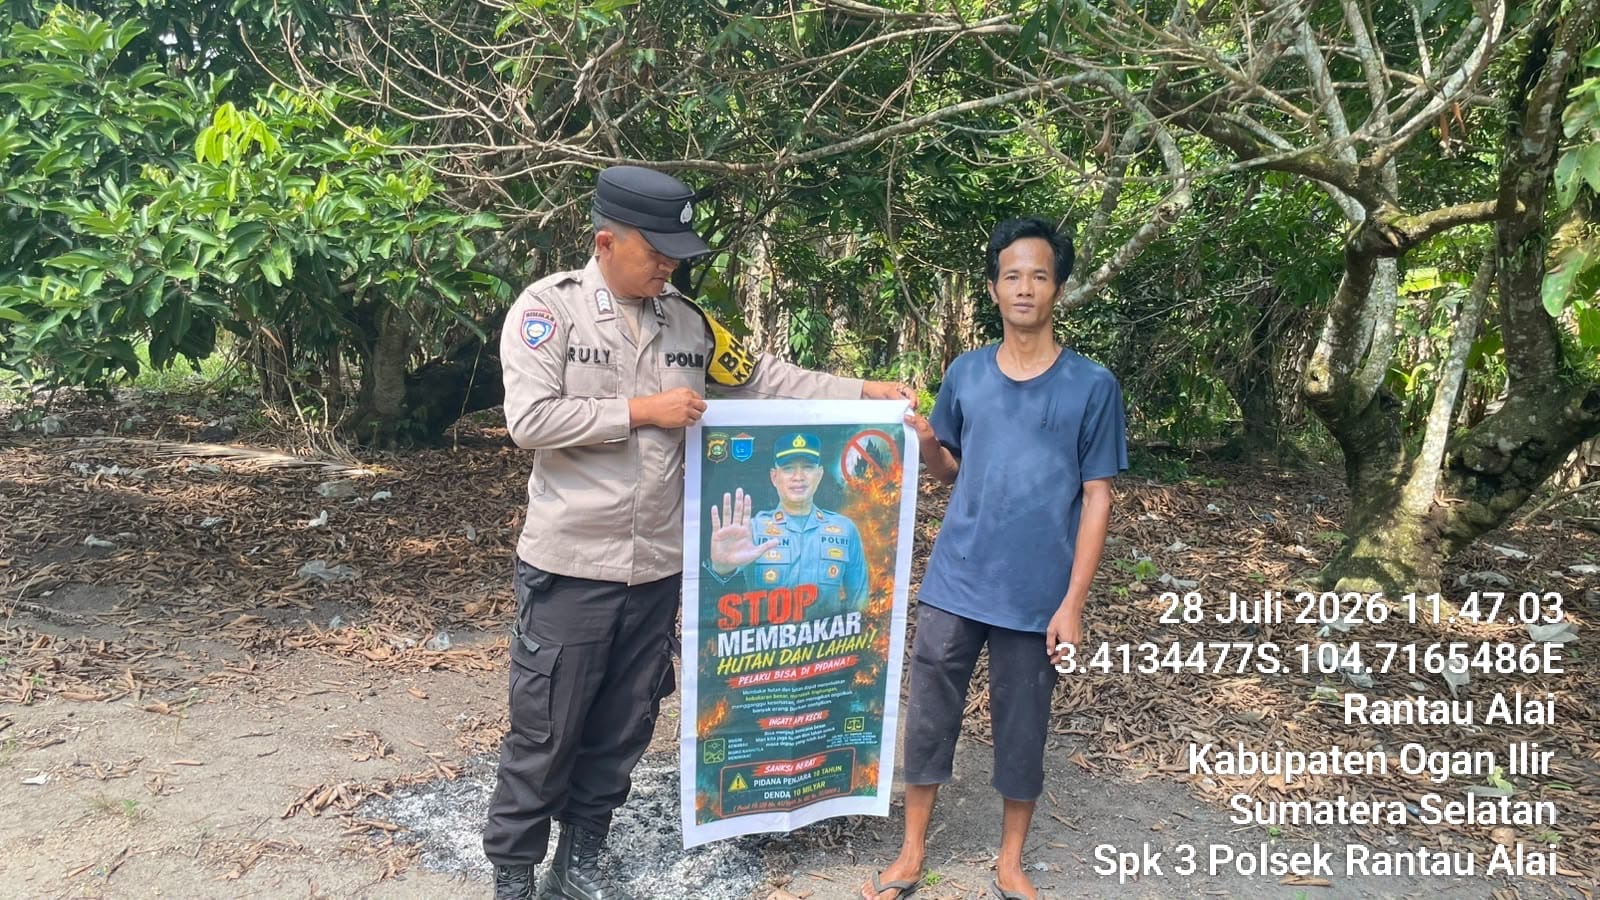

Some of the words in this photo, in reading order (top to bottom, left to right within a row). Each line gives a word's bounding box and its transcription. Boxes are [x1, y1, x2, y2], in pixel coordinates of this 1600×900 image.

[568, 347, 610, 364] RULY
[717, 583, 818, 631] STOP
[718, 611, 862, 658] MEMBAKAR
[717, 652, 774, 675] HUTAN
[779, 643, 812, 666] DAN
[816, 629, 878, 654] LAHAN!
[738, 671, 771, 686] PELAKU
[774, 668, 797, 680] BISA
[801, 665, 810, 675] DI
[814, 657, 850, 672] PIDANA!
[753, 778, 782, 787] PIDANA
[783, 773, 812, 785] PENJARA
[821, 765, 842, 775] TAHUN
[764, 762, 793, 774] SANKSI
[764, 790, 791, 800] DENDA
[793, 789, 801, 797] 10
[802, 781, 826, 794] MILYAR
